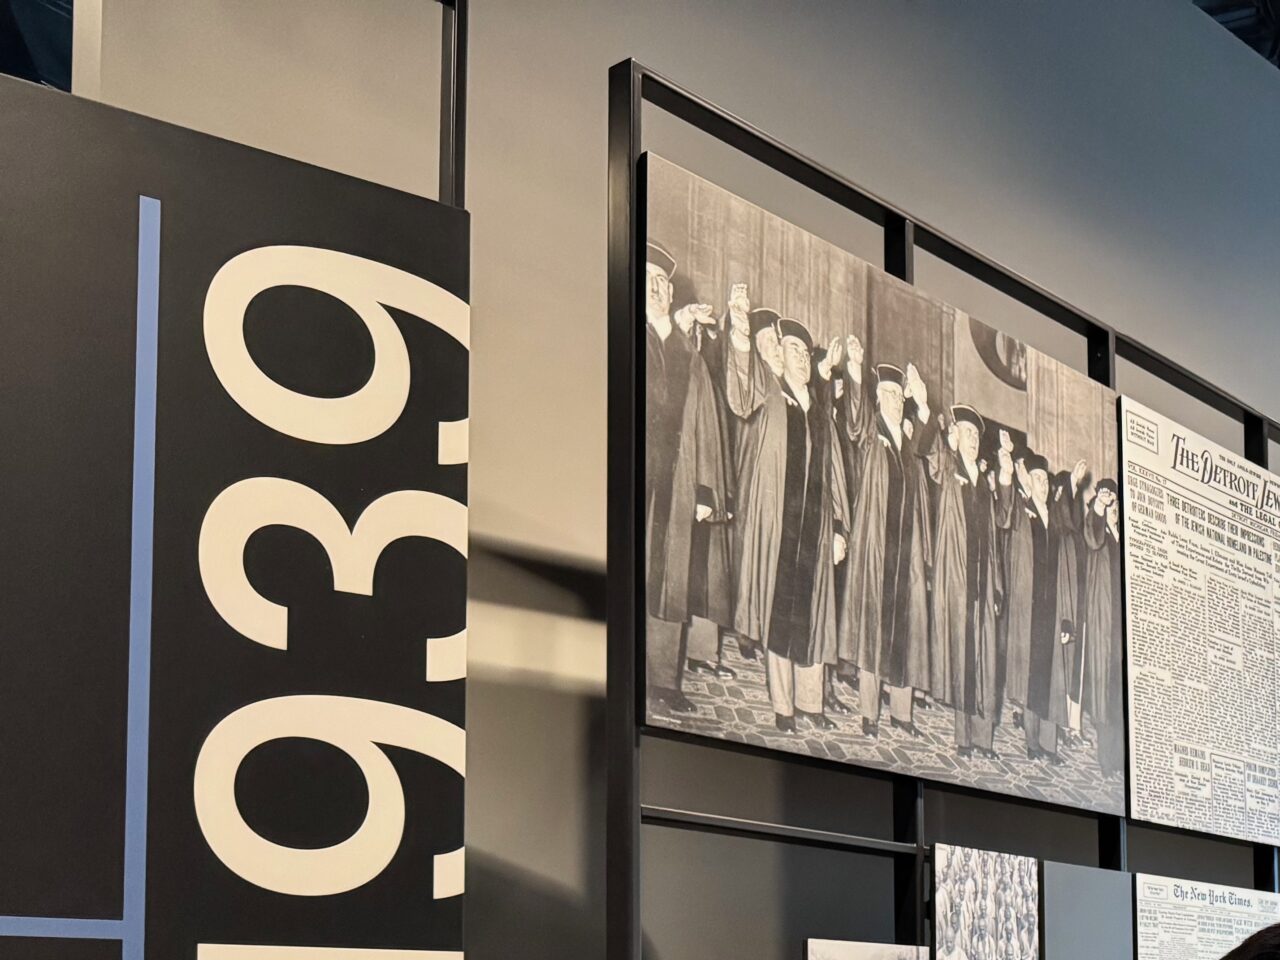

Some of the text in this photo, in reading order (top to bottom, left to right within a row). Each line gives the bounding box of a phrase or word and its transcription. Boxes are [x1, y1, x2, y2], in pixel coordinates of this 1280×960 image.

[1173, 884, 1189, 900] The
[1190, 886, 1207, 901] New
[1208, 889, 1227, 905] York
